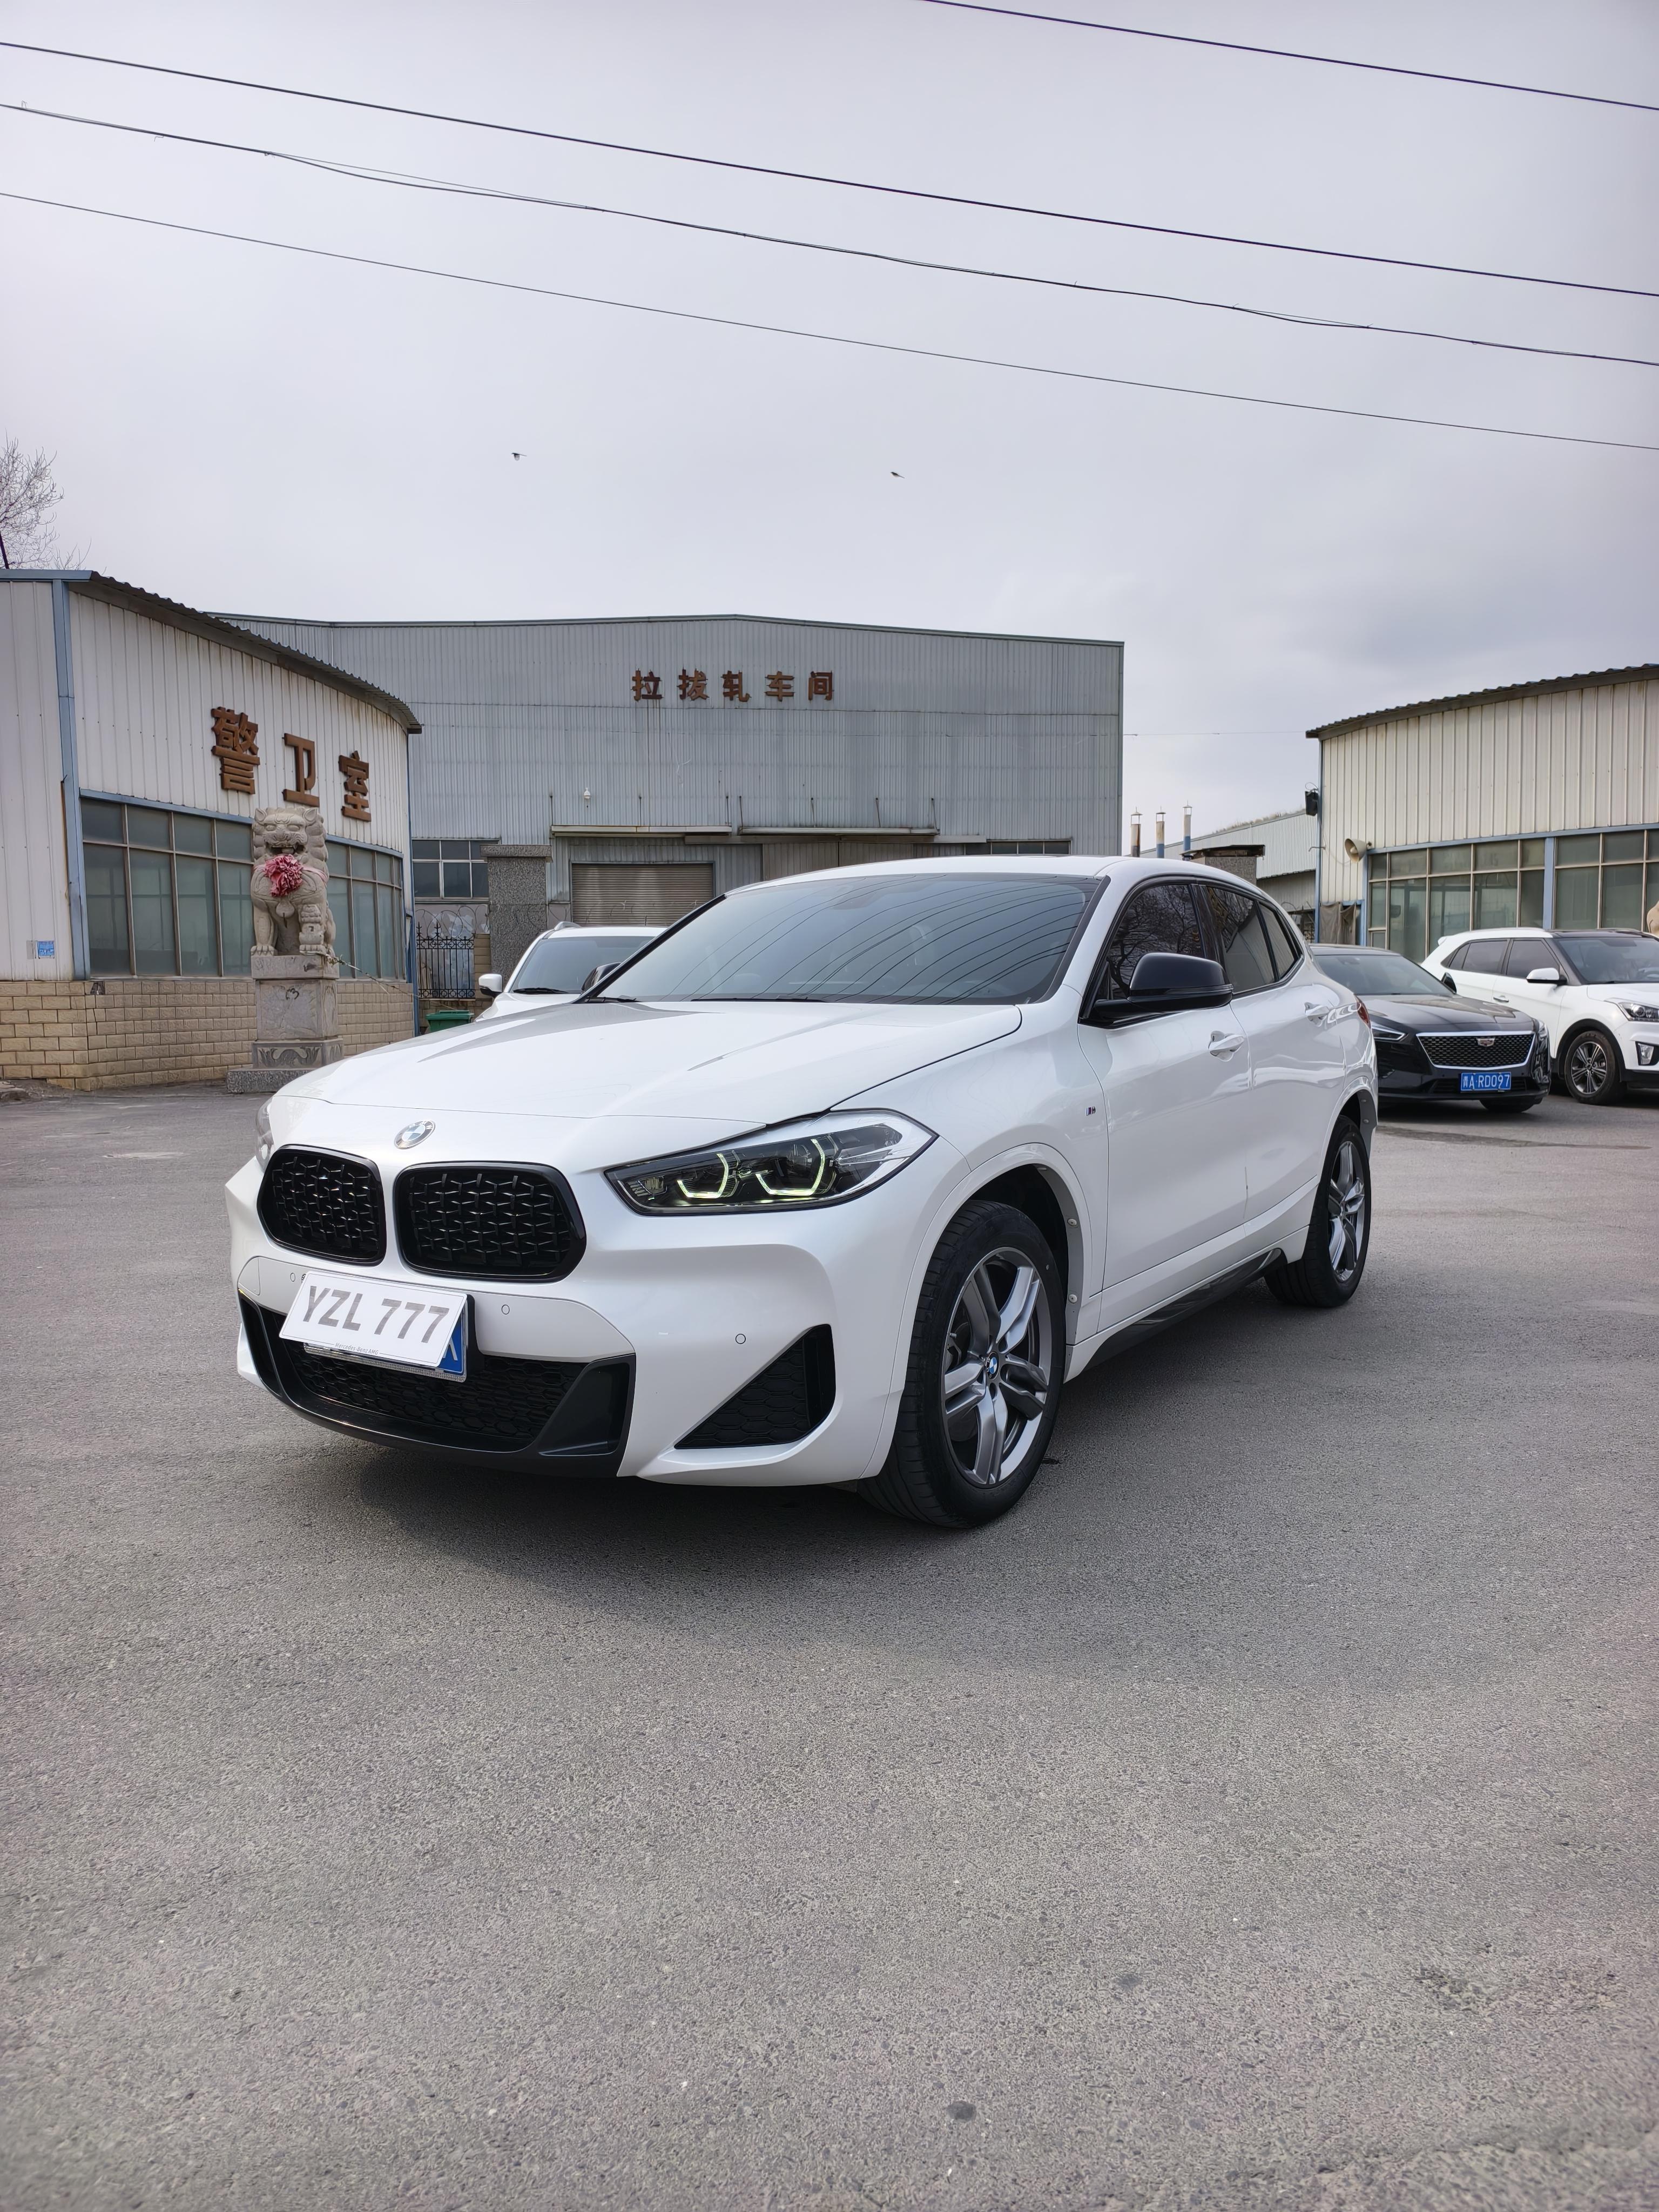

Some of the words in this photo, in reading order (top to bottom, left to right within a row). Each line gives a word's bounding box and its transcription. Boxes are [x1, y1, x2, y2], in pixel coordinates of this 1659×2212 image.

[631, 669, 833, 702] 拉拔轧车间
[211, 706, 372, 822] 警卫室
[302, 1285, 363, 1331] YZL
[374, 1298, 450, 1344] 777
[335, 1343, 368, 1353] Mercedes-Benz
